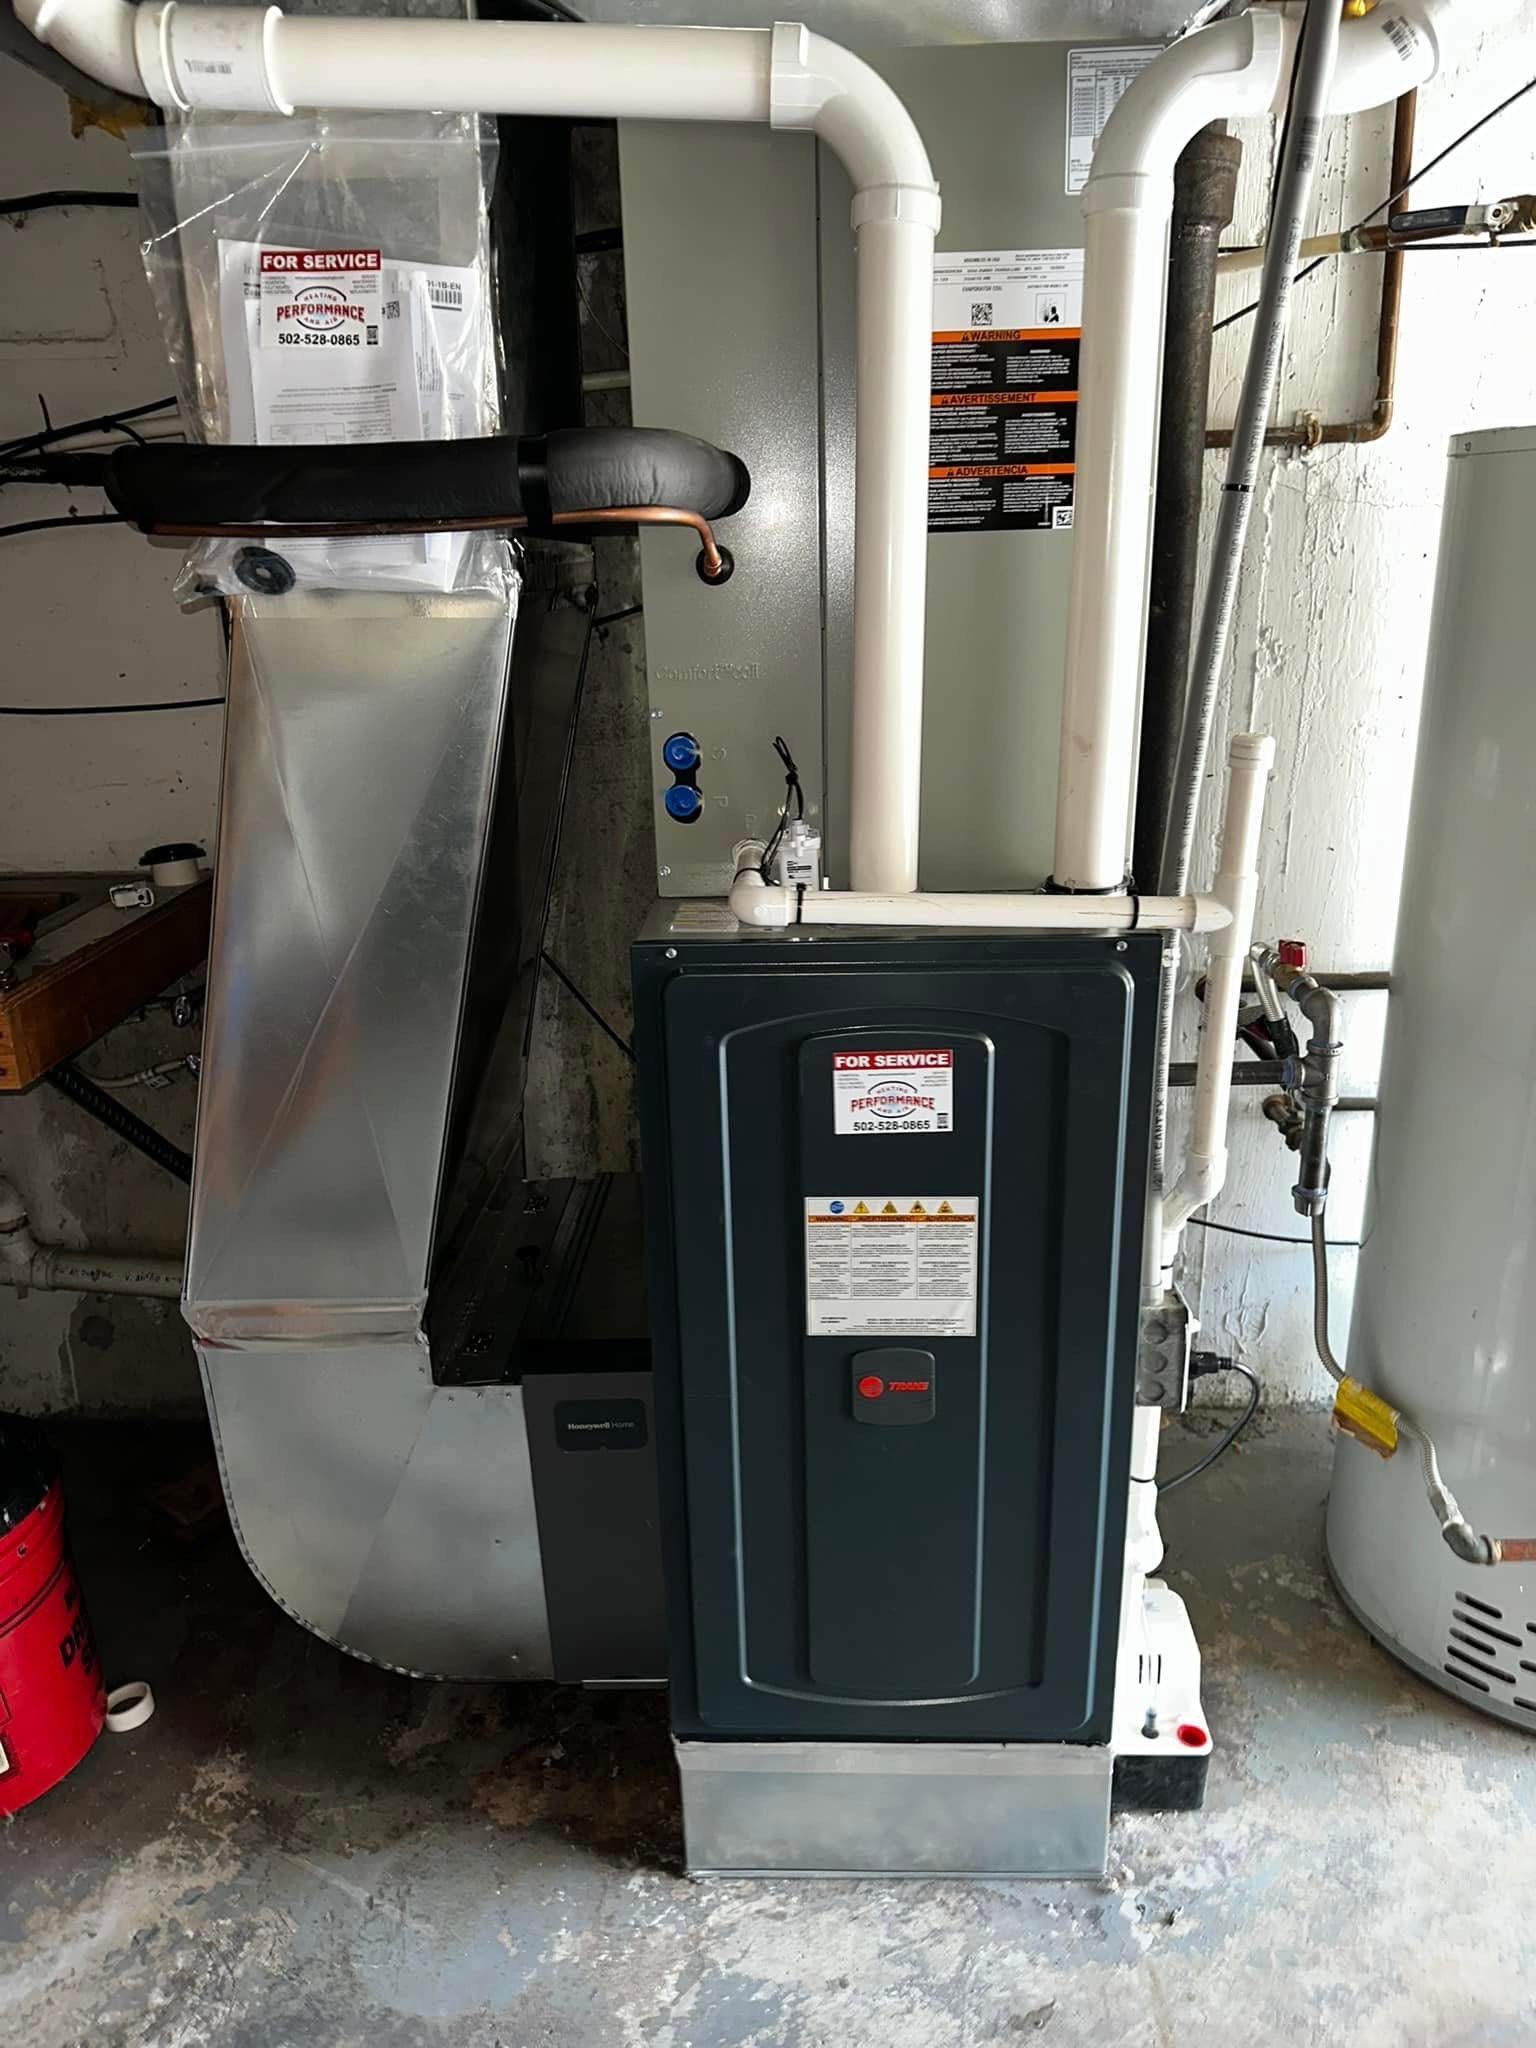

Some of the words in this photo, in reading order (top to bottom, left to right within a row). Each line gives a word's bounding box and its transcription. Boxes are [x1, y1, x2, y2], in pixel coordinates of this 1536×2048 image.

[263, 256, 298, 269] FOR
[303, 253, 377, 269] SERVICE
[303, 292, 338, 302] HEATING
[276, 303, 365, 323] PERFORMANCE
[278, 333, 360, 346] 502-528-0865
[971, 330, 1021, 341] WARNING
[950, 393, 1037, 404] AVERTISSEMENT
[956, 465, 1029, 477] ADVERTENCIA
[835, 1055, 871, 1068] FOR
[874, 1053, 949, 1067] SERVICE
[850, 1095, 935, 1112] PERFORMANCE
[853, 1120, 931, 1131] 502-528-0865
[567, 1421, 610, 1431] Honeywell
[611, 1421, 635, 1429] Home
